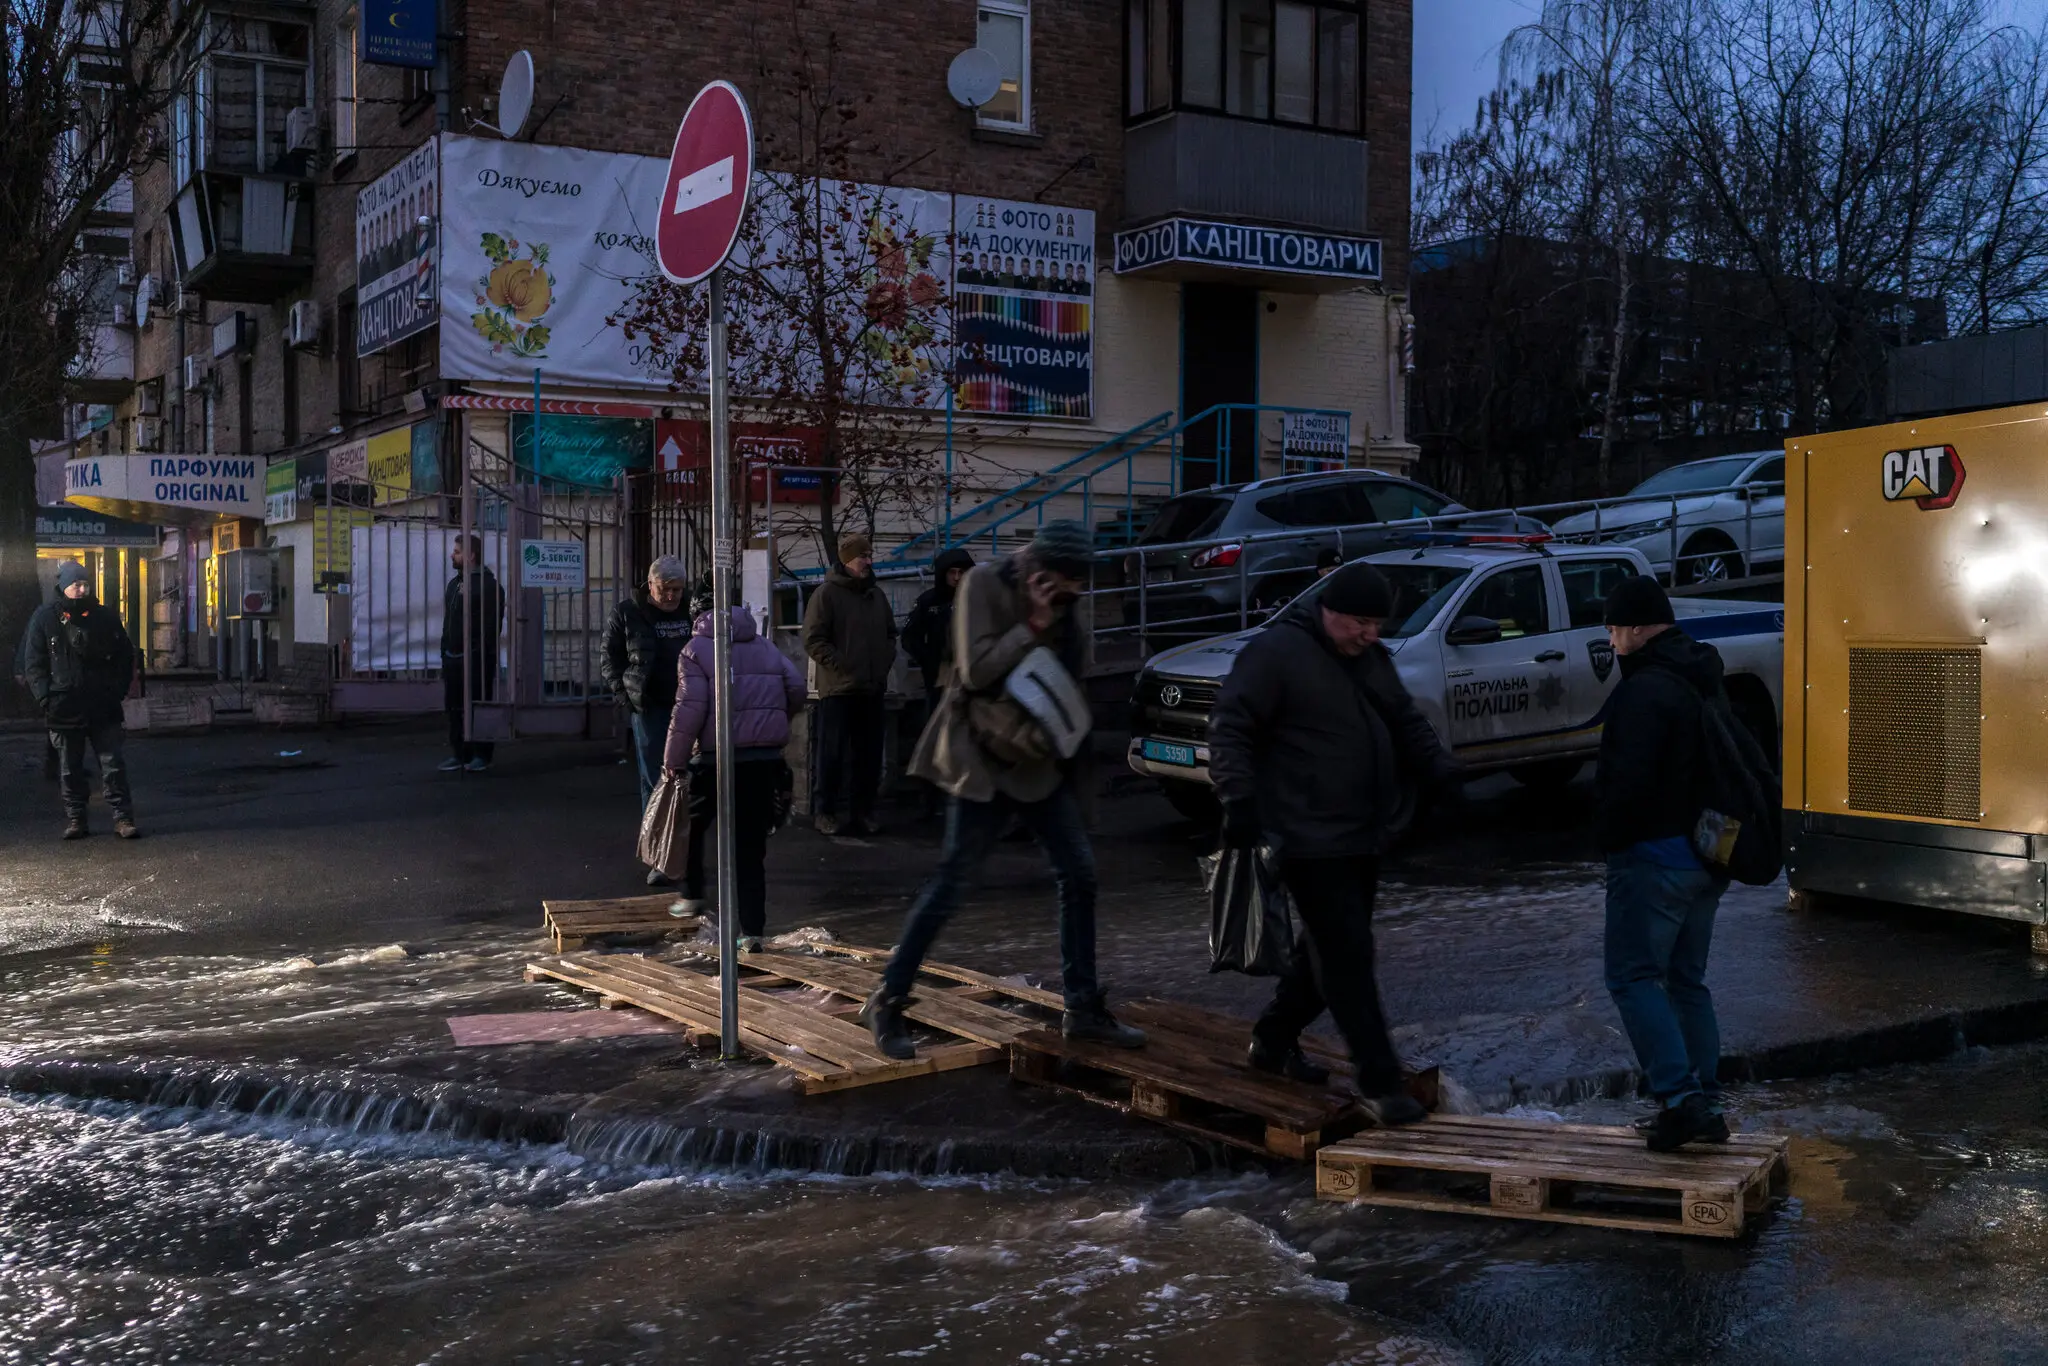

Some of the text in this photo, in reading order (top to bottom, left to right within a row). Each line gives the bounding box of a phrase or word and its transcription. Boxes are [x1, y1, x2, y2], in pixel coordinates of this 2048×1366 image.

[478, 168, 581, 198] Дякуємо
[358, 187, 377, 218] ФОТО
[378, 180, 389, 207] НА
[1002, 209, 1051, 231] ФОТО
[958, 231, 1092, 263] НА ДОКУМЕНТИ
[1120, 224, 1174, 266] ФОТО
[1185, 223, 1374, 272] КАНЦТОВАРИ
[360, 271, 436, 347] КАНЦТОВА
[1305, 418, 1328, 429] ФОТО
[1286, 429, 1346, 443] НА ДОКУМЕНТИ
[151, 459, 255, 479] ПАРФУМИ
[1883, 446, 1945, 500] CAT
[155, 483, 249, 502] ORIGINAL
[541, 553, 581, 563] S-SERVICE
[1454, 676, 1529, 697] ПАТРУЛЬНА
[1454, 694, 1529, 720] ПОЛІЦІЯ
[1694, 1205, 1722, 1221] EPAL
